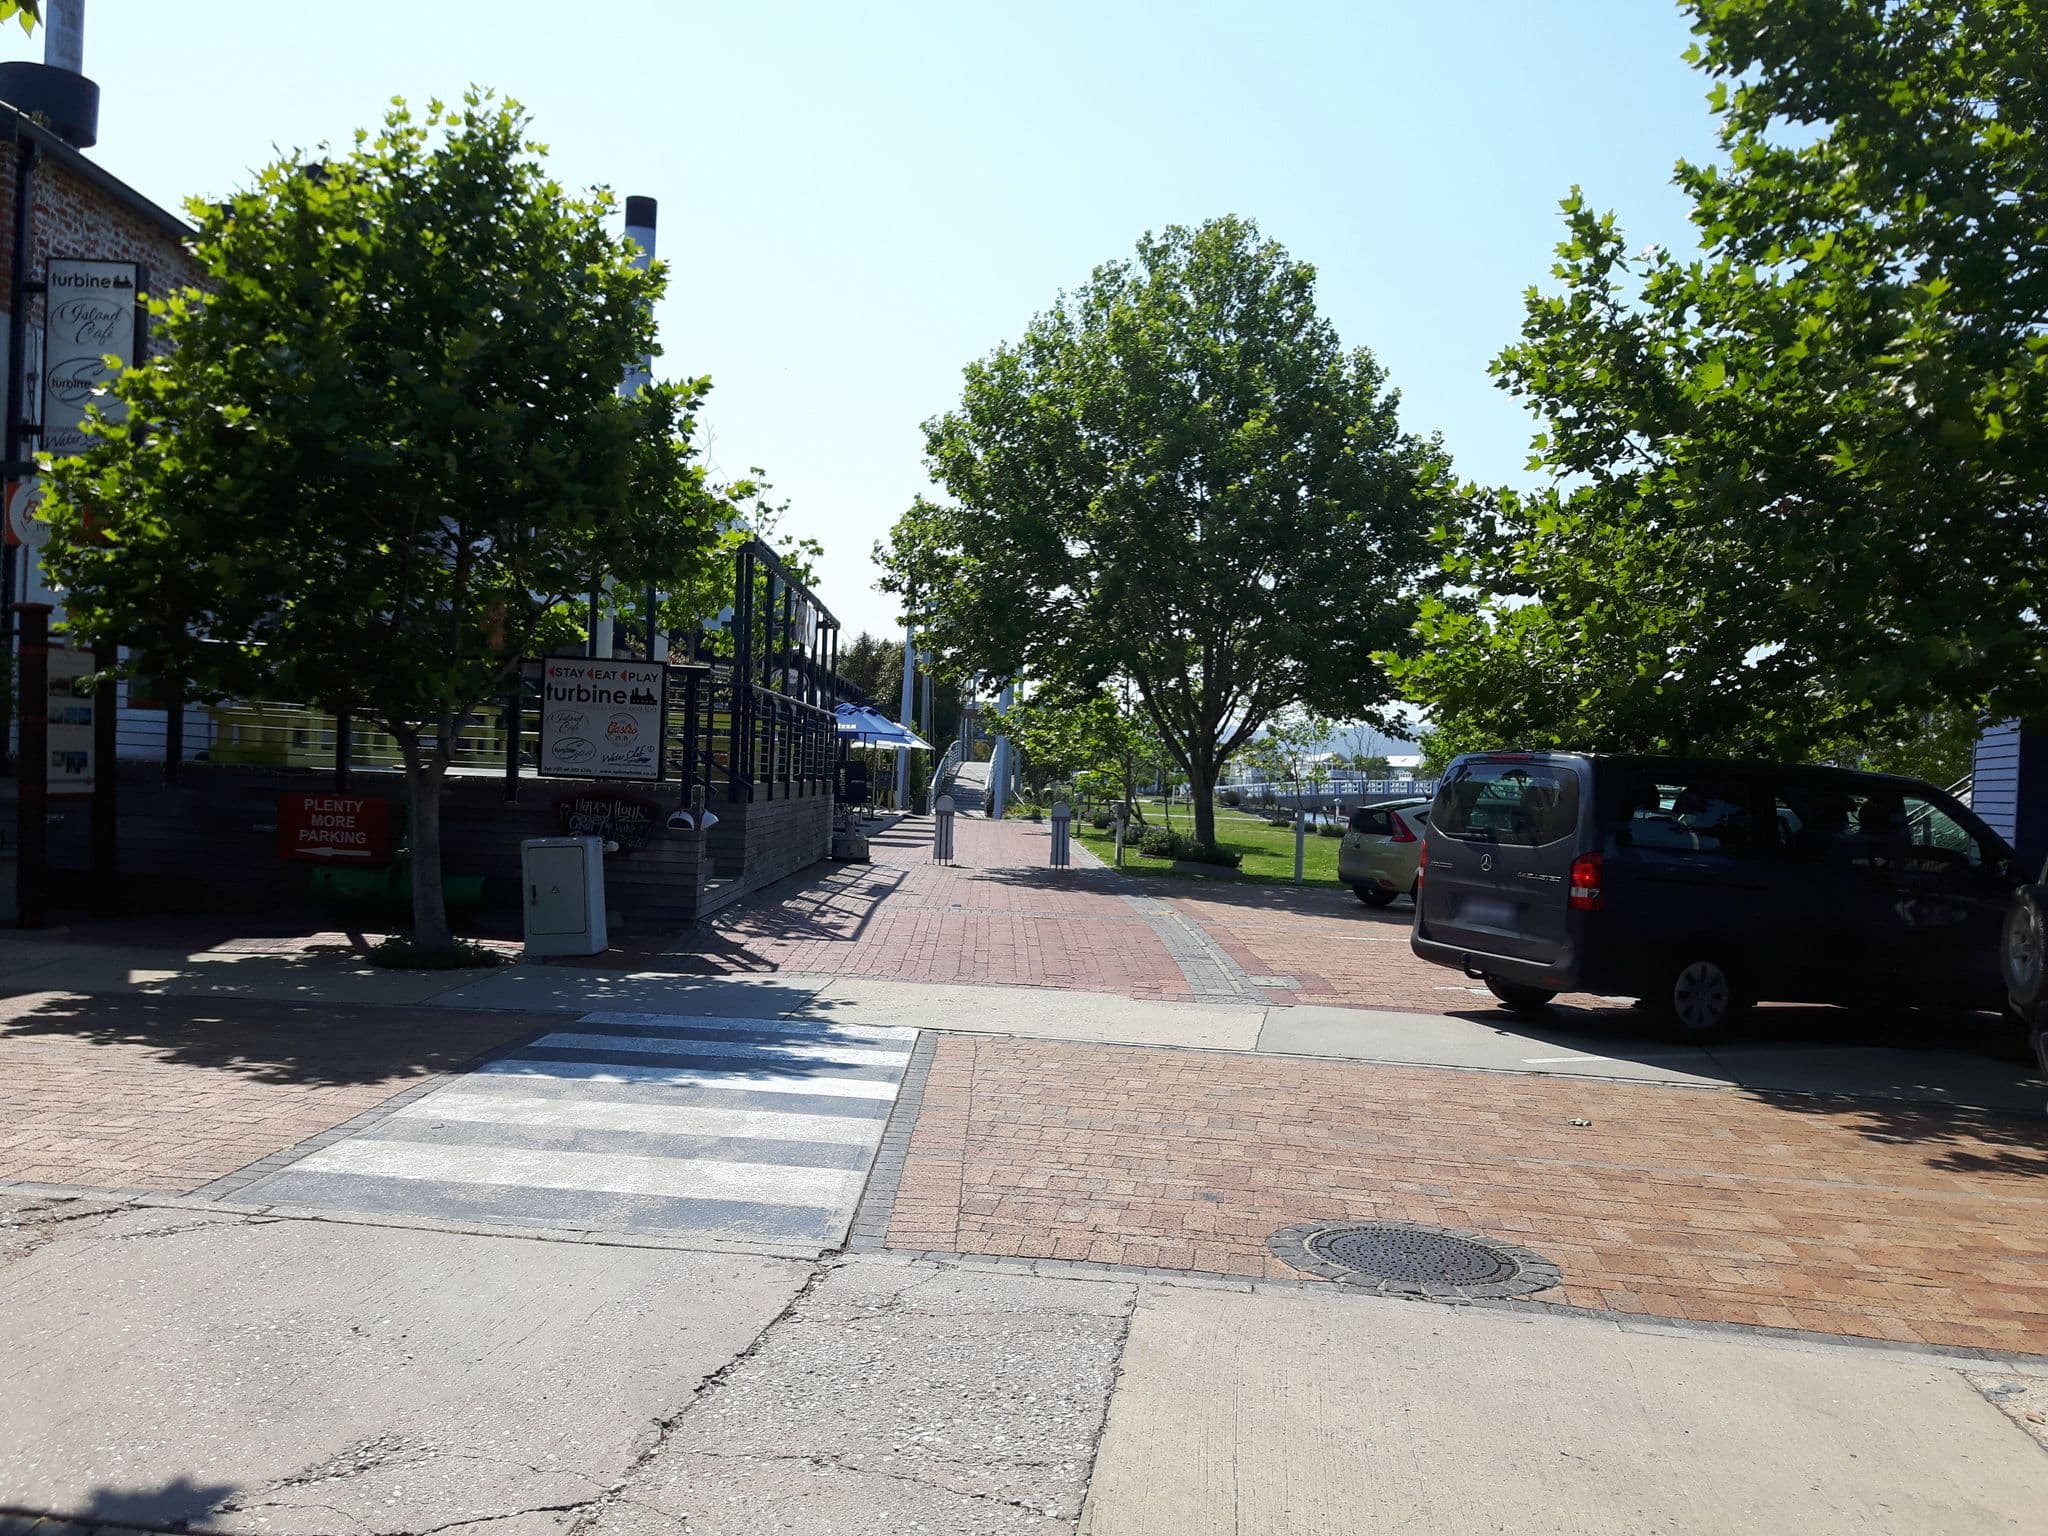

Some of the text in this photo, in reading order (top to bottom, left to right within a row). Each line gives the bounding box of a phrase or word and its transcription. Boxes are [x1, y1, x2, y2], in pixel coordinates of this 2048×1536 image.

[52, 273, 112, 289] turbine
[60, 304, 122, 327] Island
[555, 667, 659, 682] STAY EAT PLAY
[546, 683, 627, 704] turbine
[304, 799, 364, 812] PLENTY
[312, 815, 356, 828] MORE
[299, 830, 367, 844] PARKING
